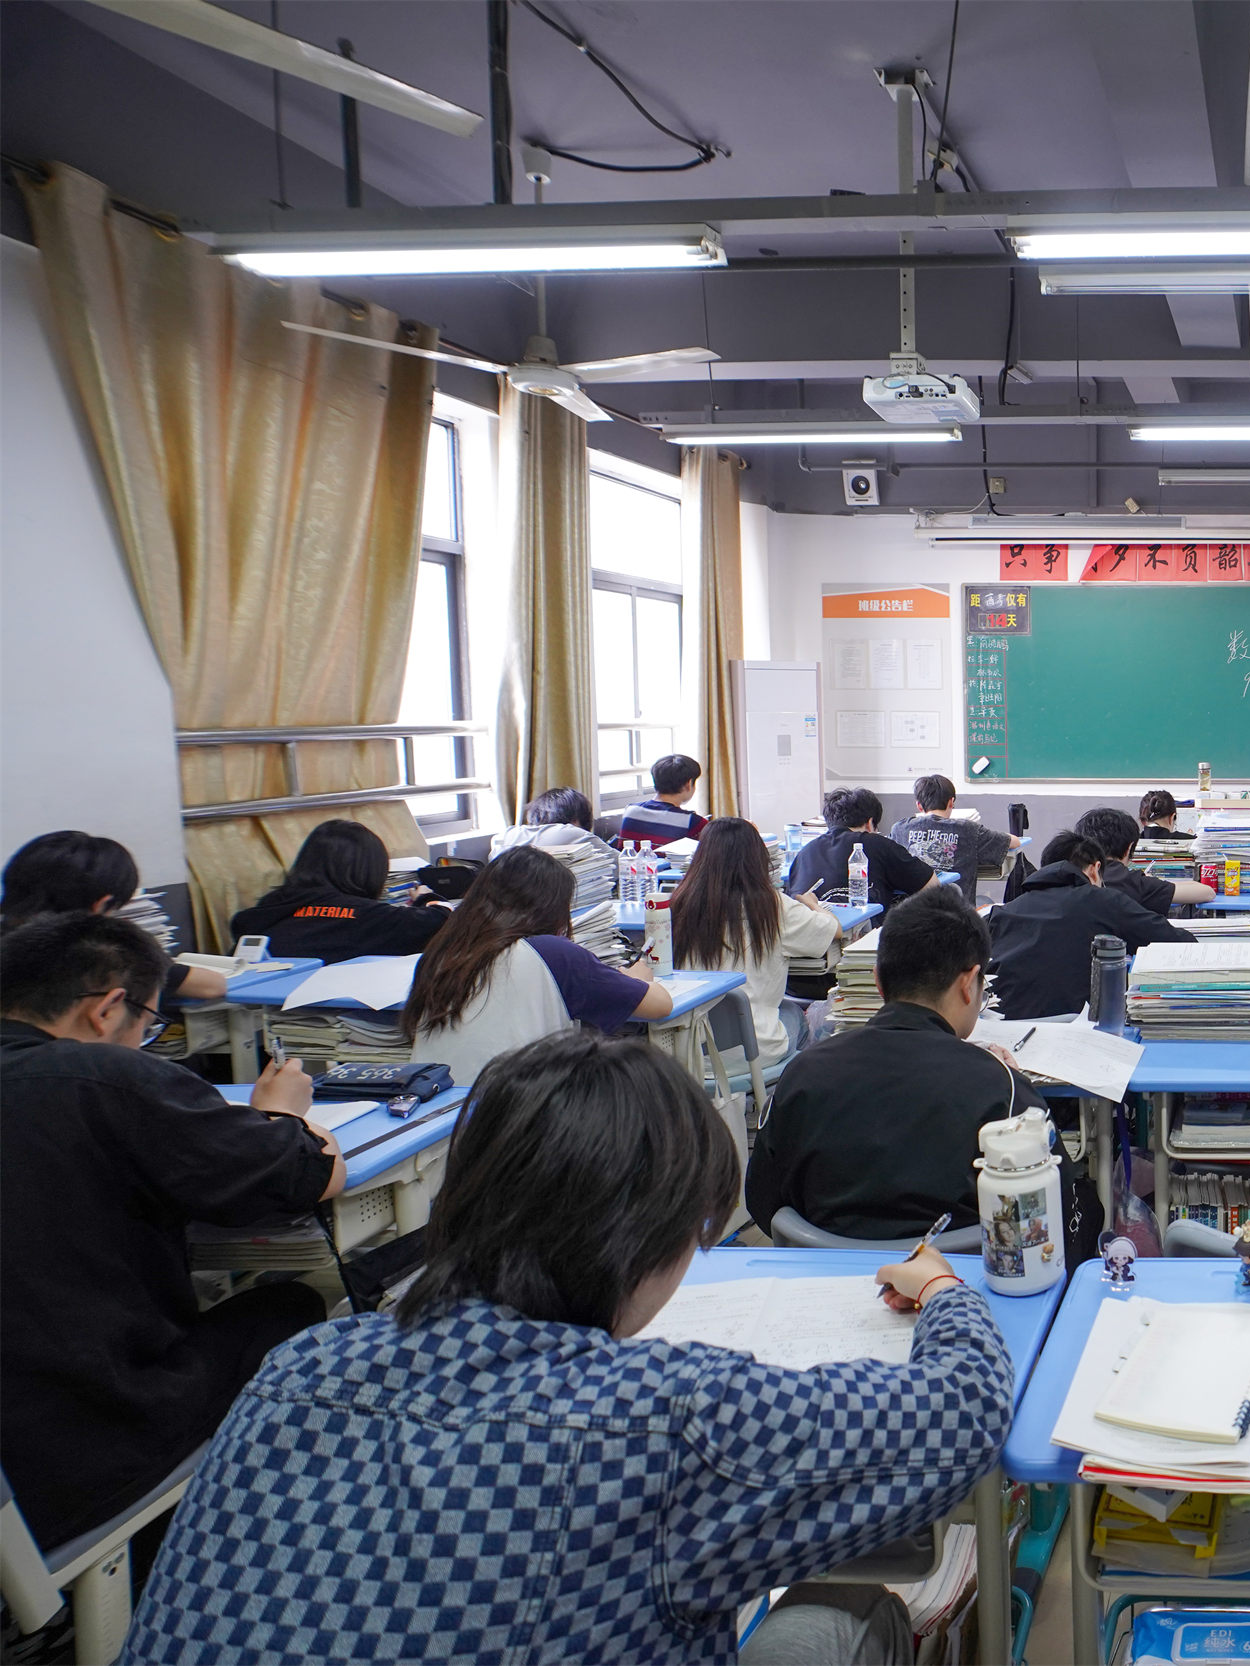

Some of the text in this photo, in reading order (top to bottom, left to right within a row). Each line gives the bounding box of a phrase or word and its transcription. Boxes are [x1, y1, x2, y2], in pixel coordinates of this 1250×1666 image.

[858, 599, 914, 612] 班级公告栏
[987, 613, 1017, 627] 14天
[908, 830, 927, 843] PEPE
[927, 829, 941, 841] THE
[293, 906, 356, 919] MATERIAL
[1210, 1629, 1232, 1638] EDI
